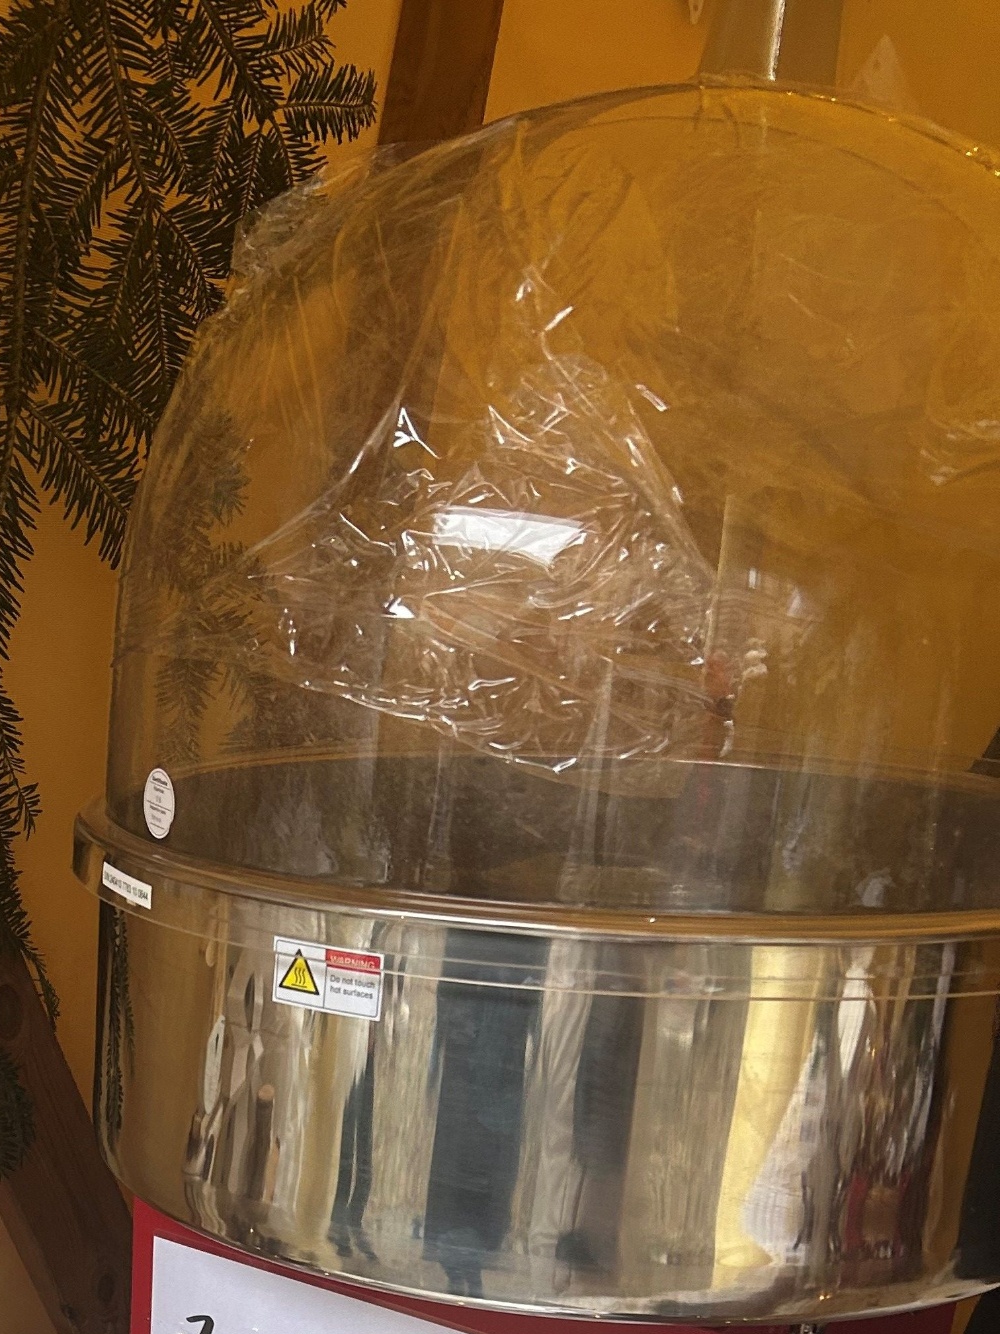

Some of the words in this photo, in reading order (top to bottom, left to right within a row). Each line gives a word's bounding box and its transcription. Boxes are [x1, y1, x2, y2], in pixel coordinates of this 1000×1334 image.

[330, 955, 376, 969] WARNING
[330, 974, 341, 984] Do
[342, 977, 353, 985] not
[354, 979, 375, 989] touch
[330, 985, 341, 994] hot
[343, 988, 373, 999] surfaces
